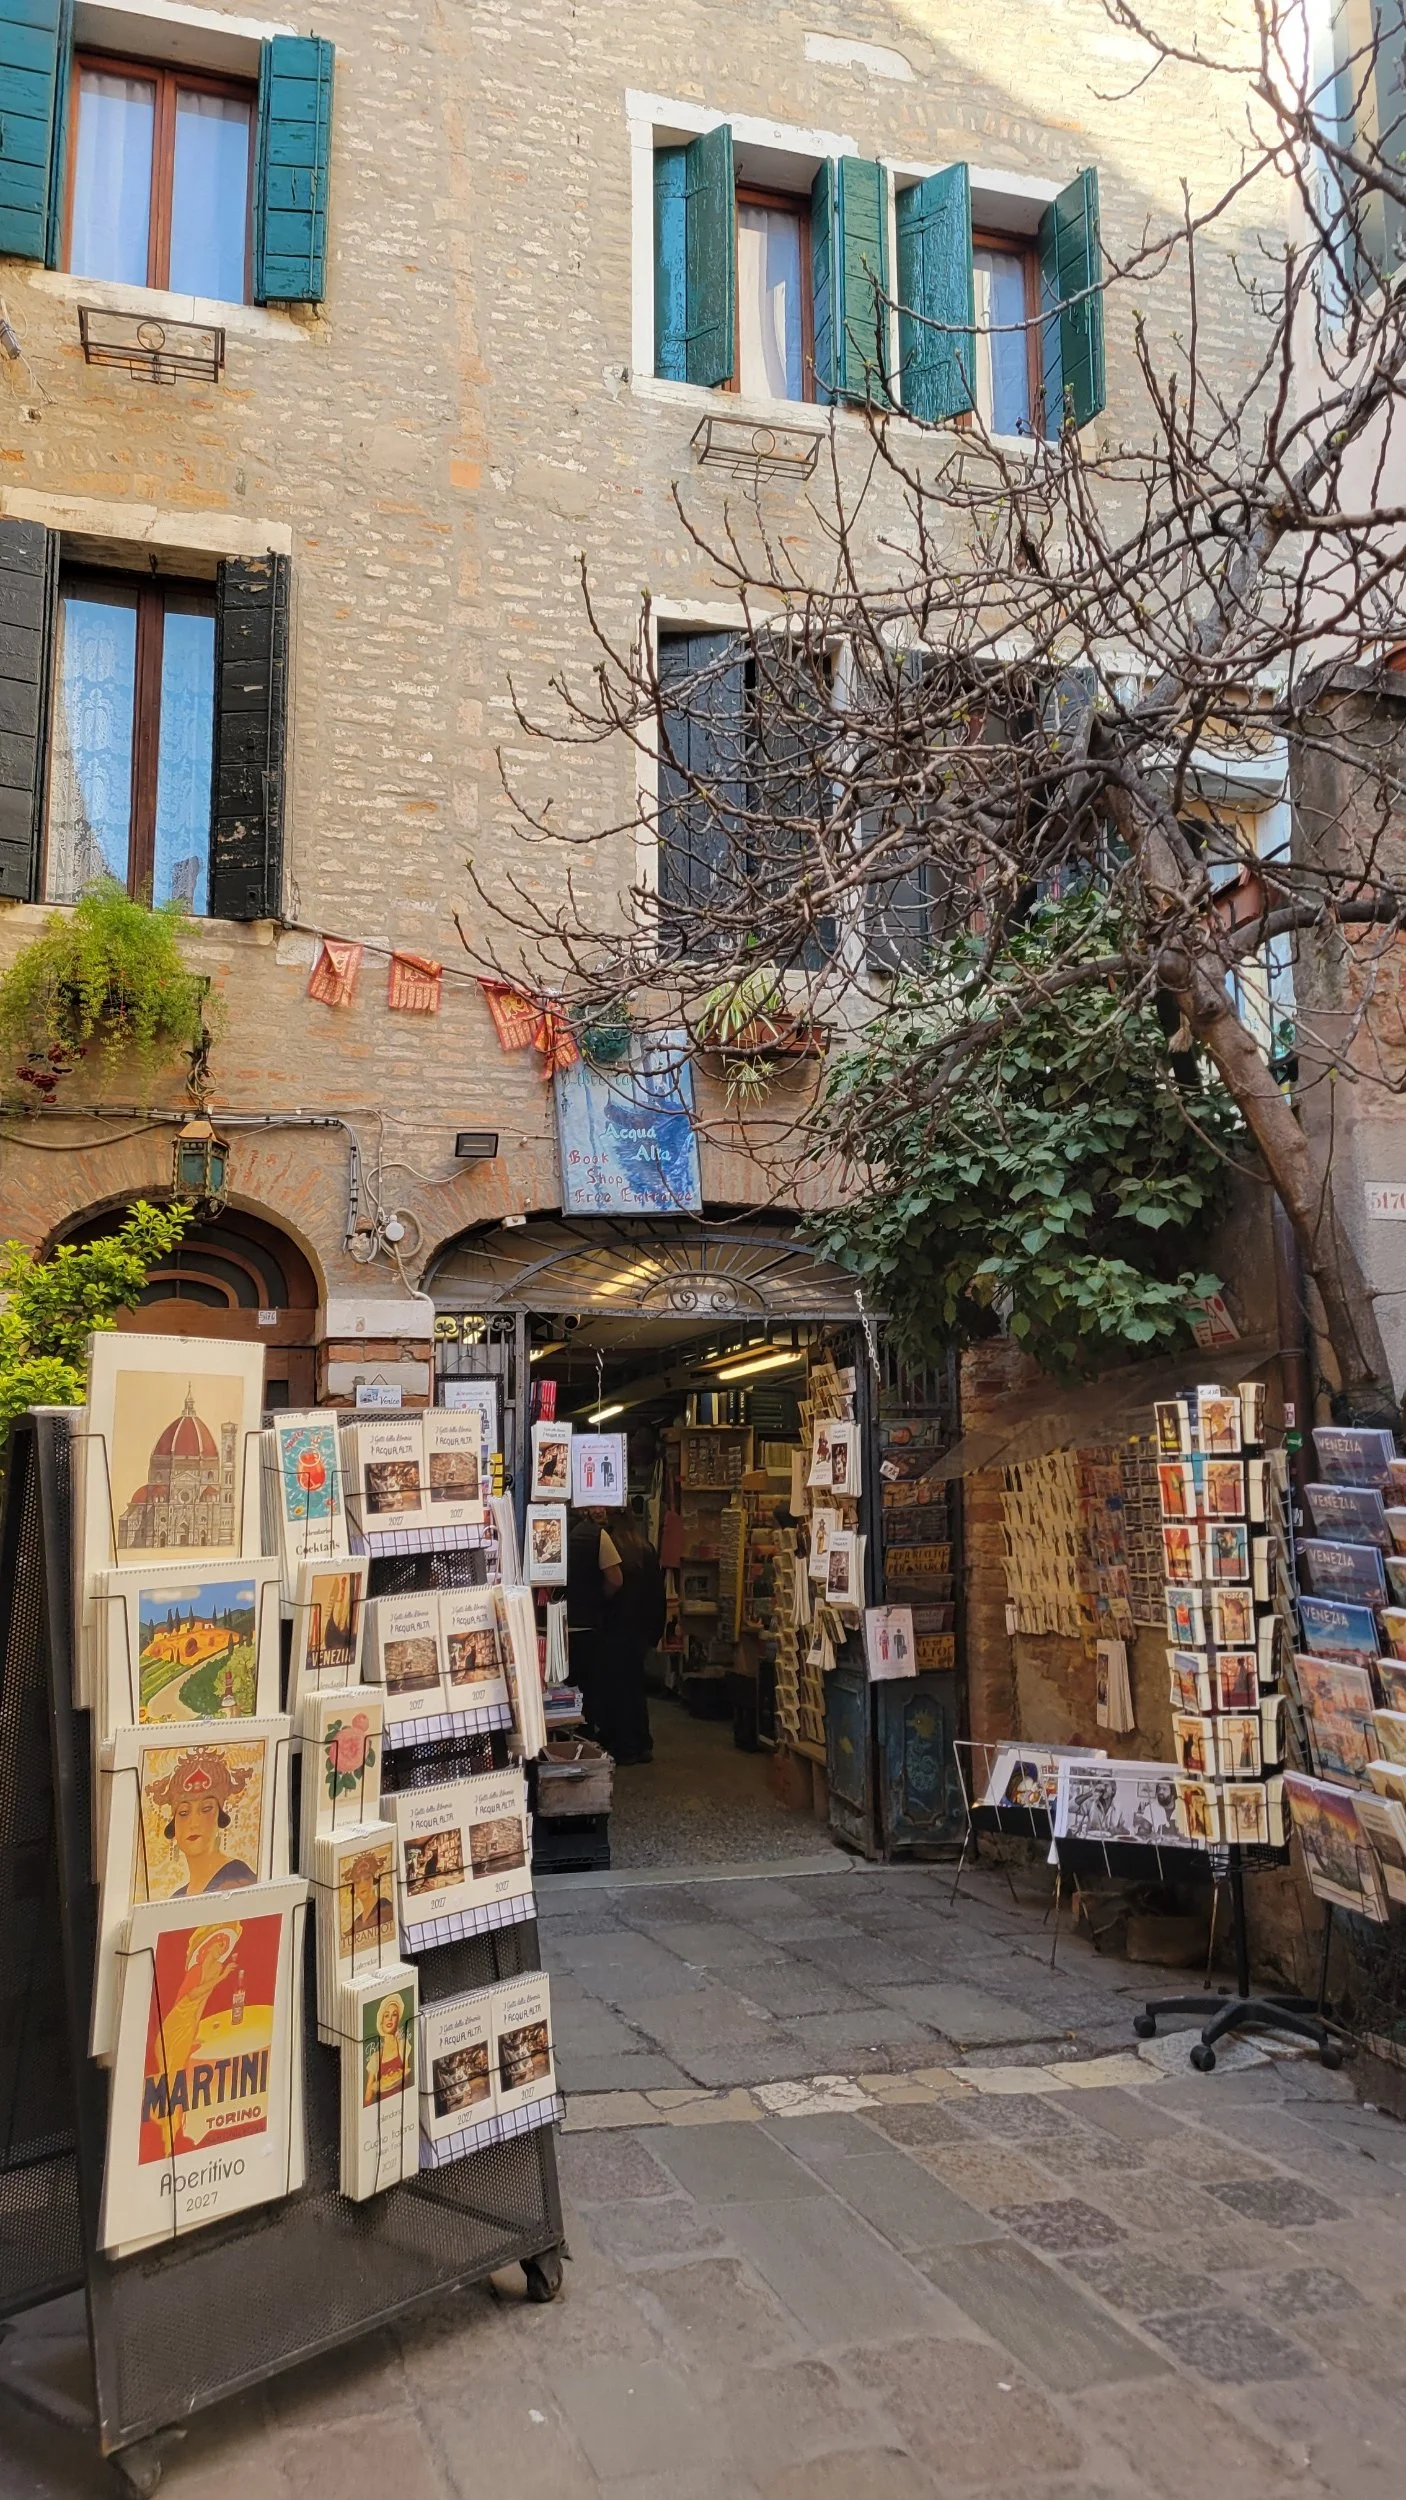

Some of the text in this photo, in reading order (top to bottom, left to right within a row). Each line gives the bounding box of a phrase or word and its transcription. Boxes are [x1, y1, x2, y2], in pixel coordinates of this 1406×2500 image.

[600, 1123, 657, 1142] Acqua
[569, 1150, 609, 1165] Book
[631, 1145, 672, 1161] Alta
[586, 1168, 623, 1187] Shop
[575, 1188, 612, 1203] Free
[376, 1445, 412, 1456] ACQUA ALTA
[440, 1438, 460, 1446] ACQUA
[1318, 1438, 1362, 1453] VENEZIA
[1311, 1494, 1357, 1510] VENEZIA
[1308, 1548, 1355, 1568] VENEZIA
[456, 1614, 488, 1626] ACQUA ALTA
[1302, 1605, 1350, 1628] VENEZIA
[395, 1621, 430, 1634] ACQUA ALTA
[480, 1799, 516, 1814] ACQUA ALTA
[416, 1812, 454, 1829] ACQUA ALTA
[508, 2004, 542, 2022] ACQUA ALTA
[444, 2026, 482, 2046] ACQUA ALTA
[141, 2050, 269, 2122] MARTINI
[206, 2106, 261, 2128] TORINO
[160, 2158, 245, 2197] Aperitivo
[186, 2191, 218, 2212] 2027
